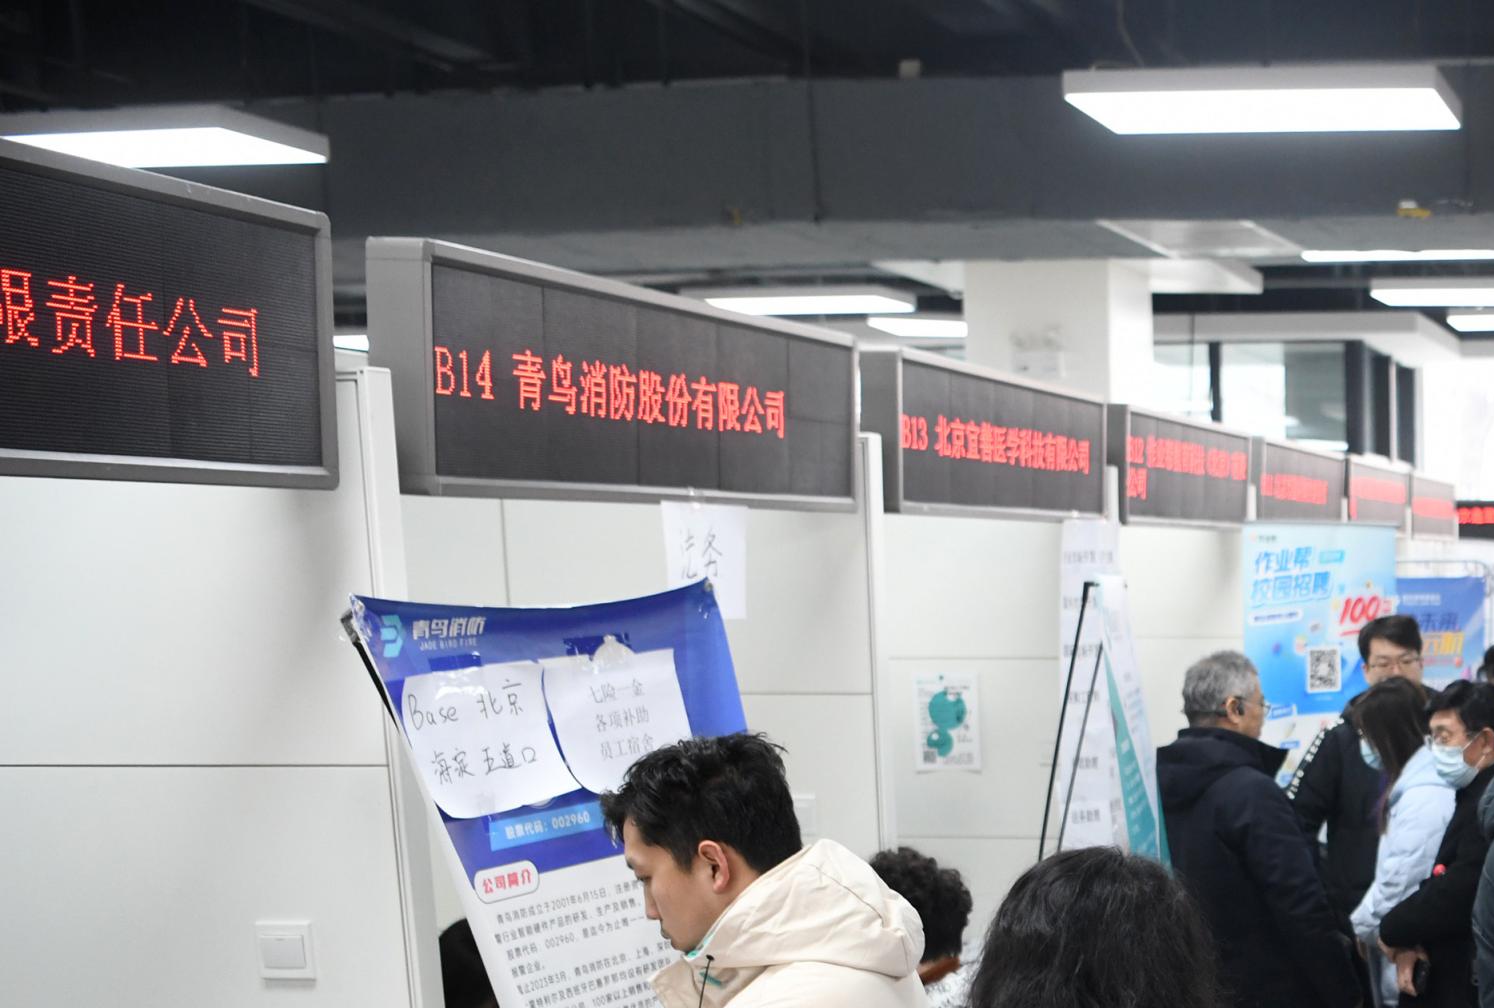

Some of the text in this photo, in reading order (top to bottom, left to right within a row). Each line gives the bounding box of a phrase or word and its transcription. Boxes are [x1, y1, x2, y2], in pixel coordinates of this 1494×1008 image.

[435, 345, 785, 439] B14 青鸟消防股份有限公司
[901, 414, 928, 451] B13
[1254, 546, 1313, 575] 作业帮
[1250, 571, 1332, 604] 校园招聘
[1339, 595, 1382, 626] 100
[412, 616, 487, 641] 青鸟消防
[407, 679, 524, 731] Base 北京
[482, 868, 532, 895] 公司简介
